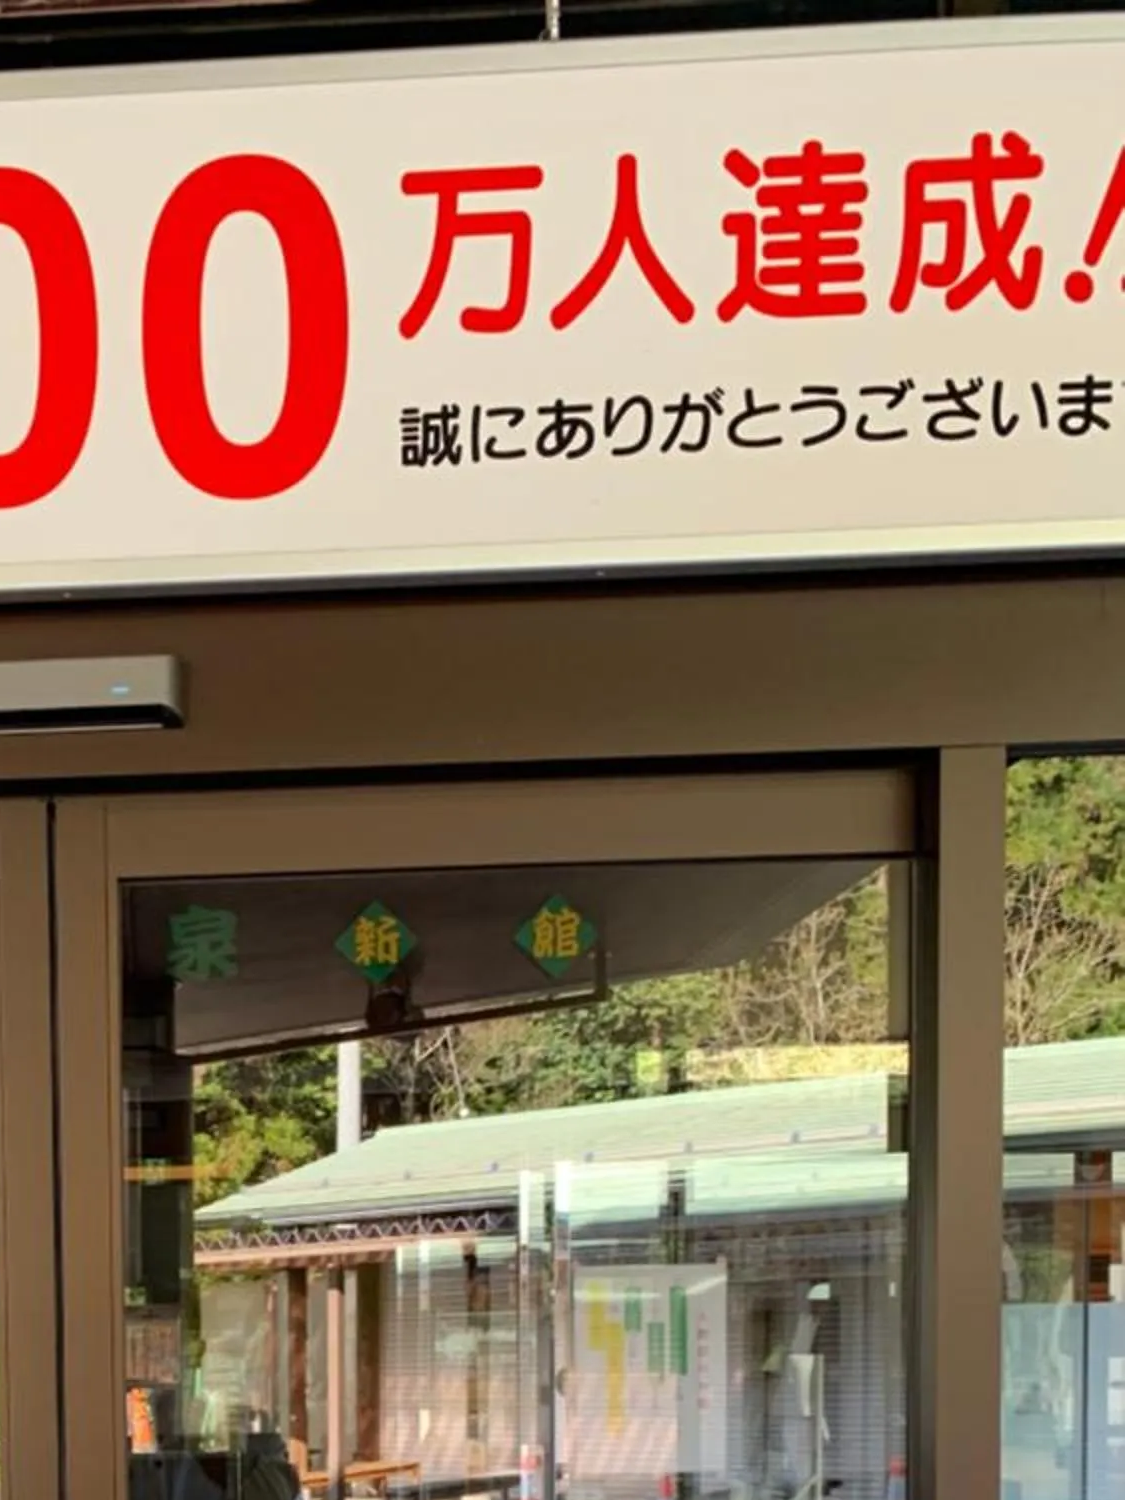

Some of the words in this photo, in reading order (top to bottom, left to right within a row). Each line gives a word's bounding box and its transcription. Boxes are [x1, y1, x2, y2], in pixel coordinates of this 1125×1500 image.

[398, 130, 1125, 340] 万人達成!
[399, 374, 1125, 468] 誠にありがとうございま
